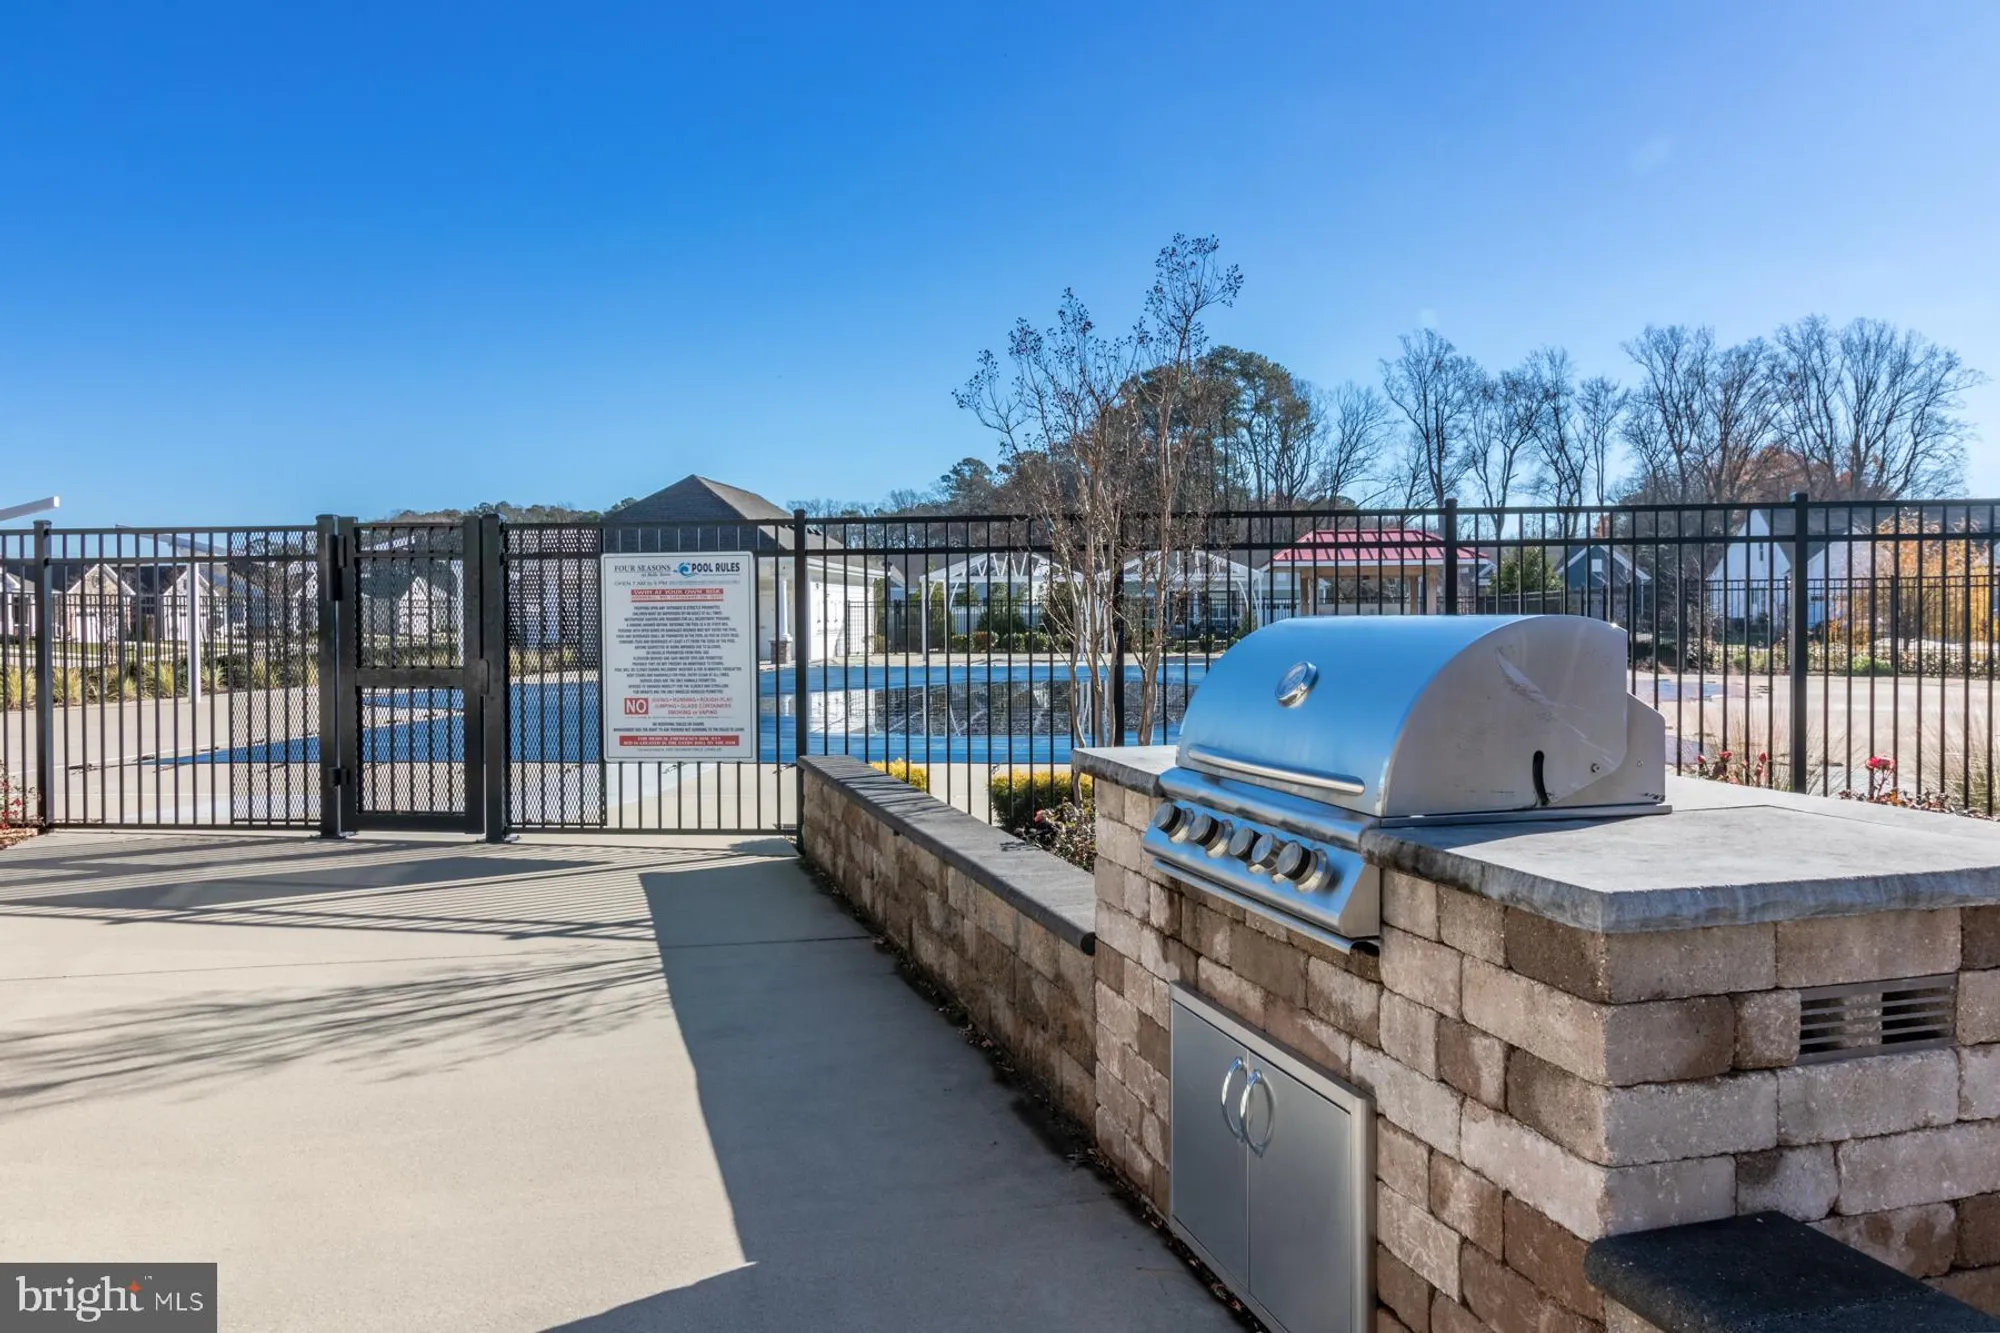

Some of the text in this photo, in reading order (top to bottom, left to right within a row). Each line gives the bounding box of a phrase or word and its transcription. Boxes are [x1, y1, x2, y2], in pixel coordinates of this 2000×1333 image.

[614, 564, 671, 573] FOUR SEASONS
[692, 562, 740, 573] POOL RULES
[626, 699, 647, 713] NO
